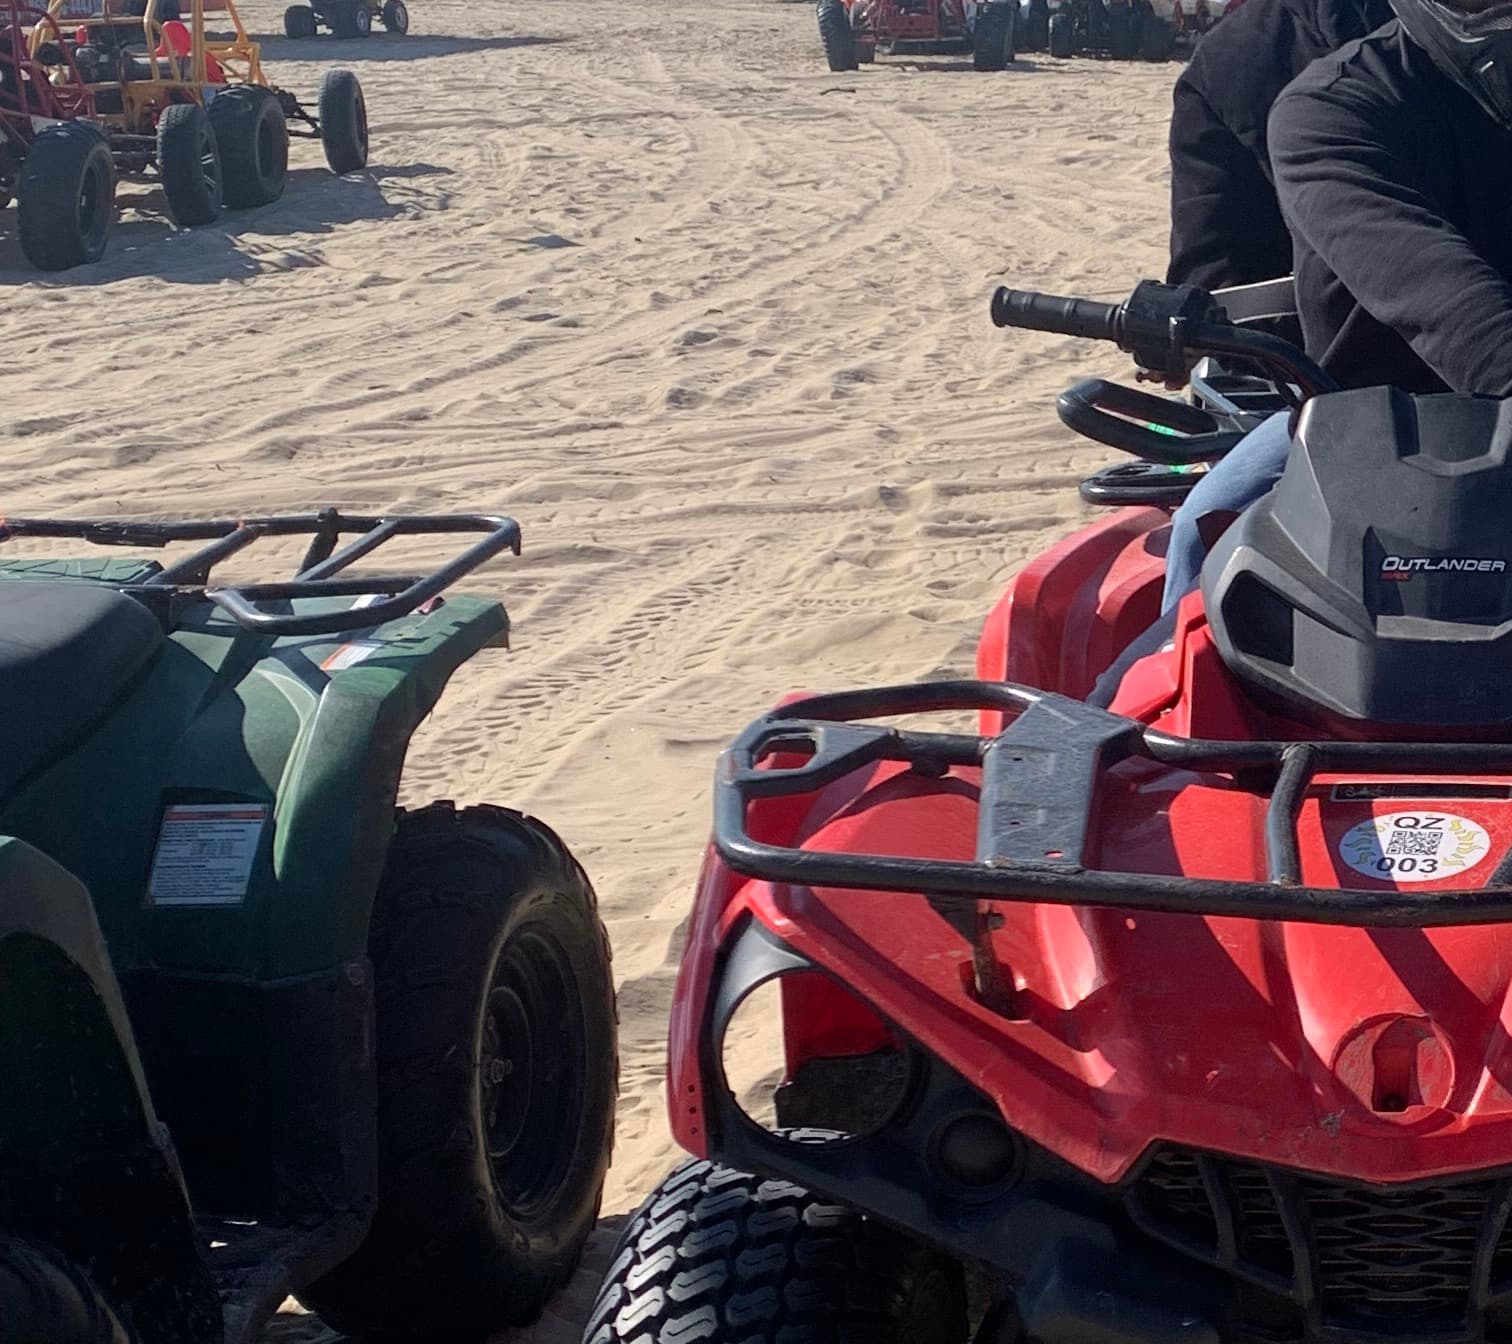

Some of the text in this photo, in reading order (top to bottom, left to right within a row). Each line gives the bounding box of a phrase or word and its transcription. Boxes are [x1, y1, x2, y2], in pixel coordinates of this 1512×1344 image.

[1381, 557, 1506, 572] OUTLANDER
[1394, 816, 1446, 830] QZ
[1376, 857, 1438, 873] 003
